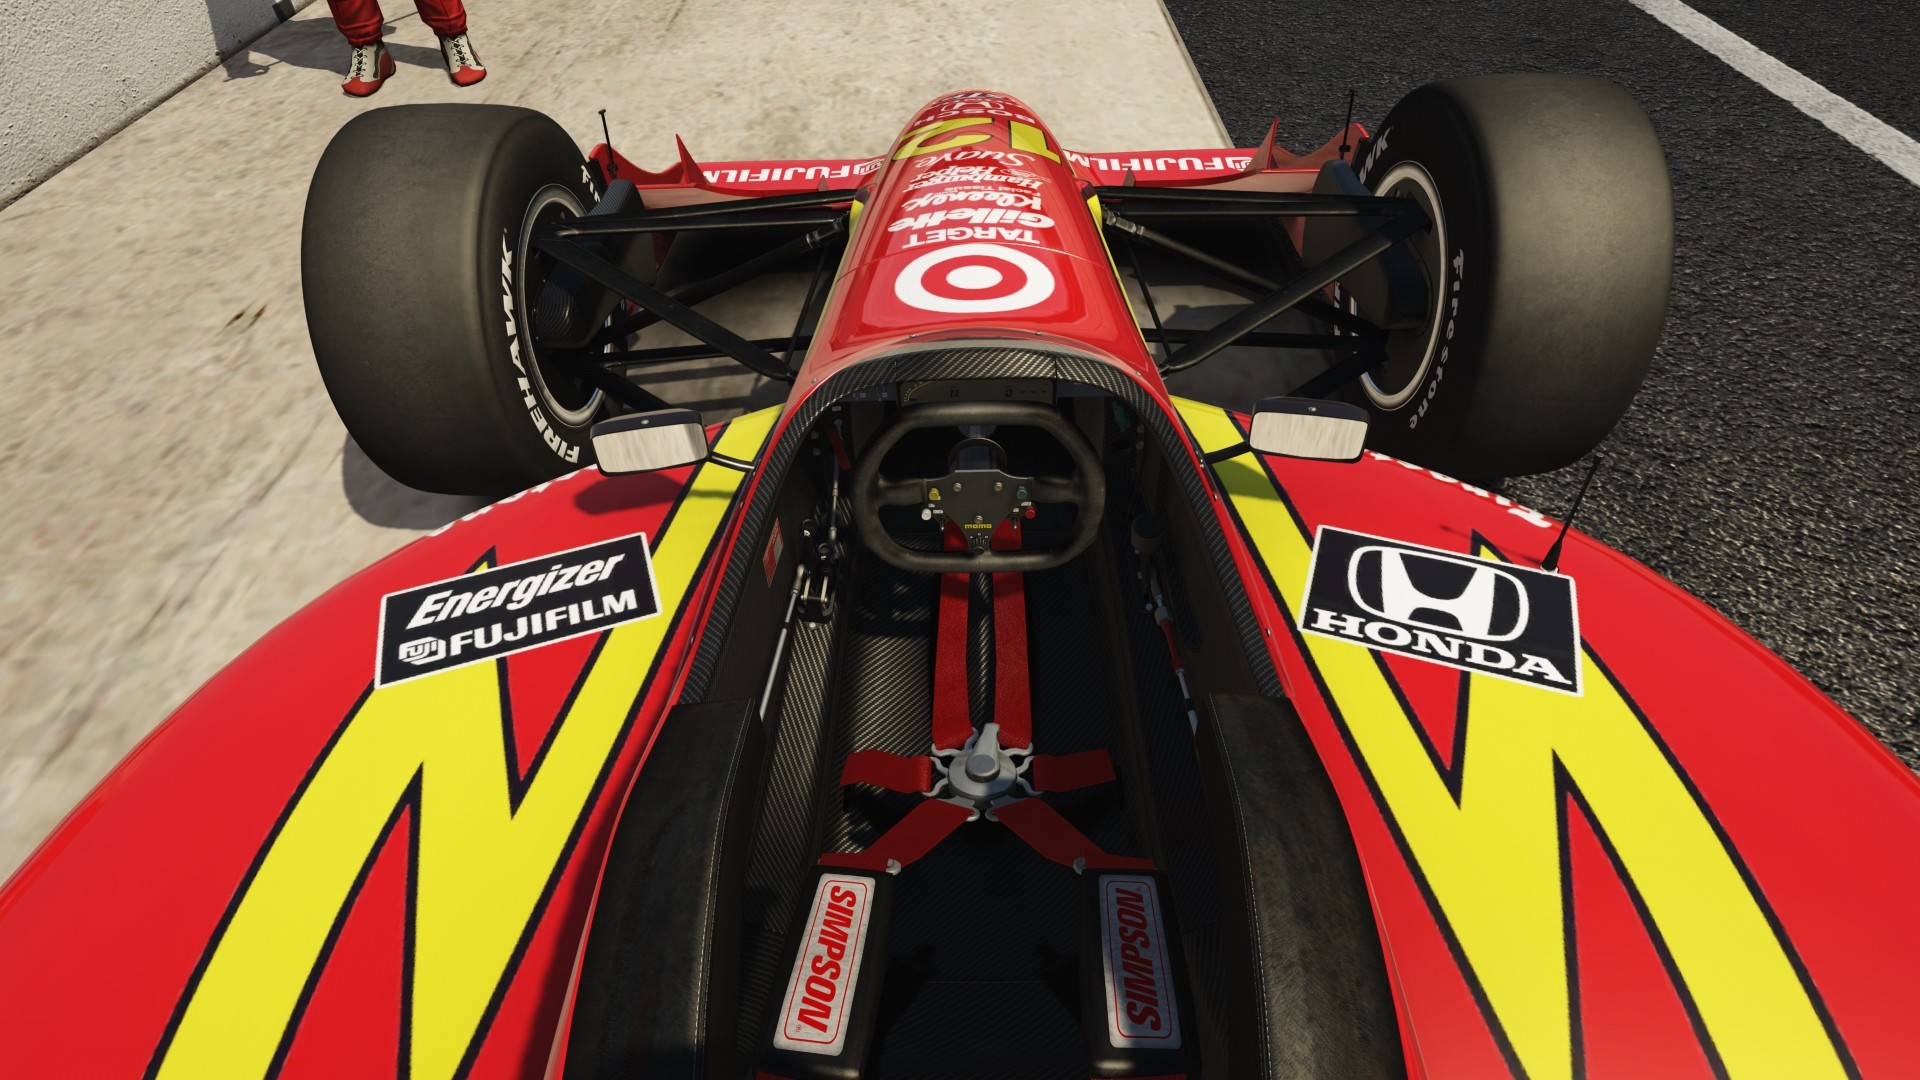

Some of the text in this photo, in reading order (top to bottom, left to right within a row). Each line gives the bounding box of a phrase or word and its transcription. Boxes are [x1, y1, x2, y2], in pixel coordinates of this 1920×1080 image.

[914, 109, 1035, 127] BOSCH
[893, 117, 1062, 165] 12
[910, 165, 999, 183] Helper
[914, 150, 1036, 169] Suave
[901, 191, 1042, 211] Kleenex
[903, 174, 1044, 193] Hamburger
[944, 185, 996, 193] Tissue
[888, 207, 1055, 232] Gillette
[902, 226, 1040, 249] TARGET
[501, 233, 580, 464] FIREHAWK
[1408, 249, 1465, 430] Firestone
[405, 553, 625, 630] Energizer
[450, 589, 638, 657] FUJIFILM
[1310, 608, 1573, 686] HONDA
[798, 885, 857, 1034] SIMPSON
[1114, 887, 1162, 1032] SIMPSON
